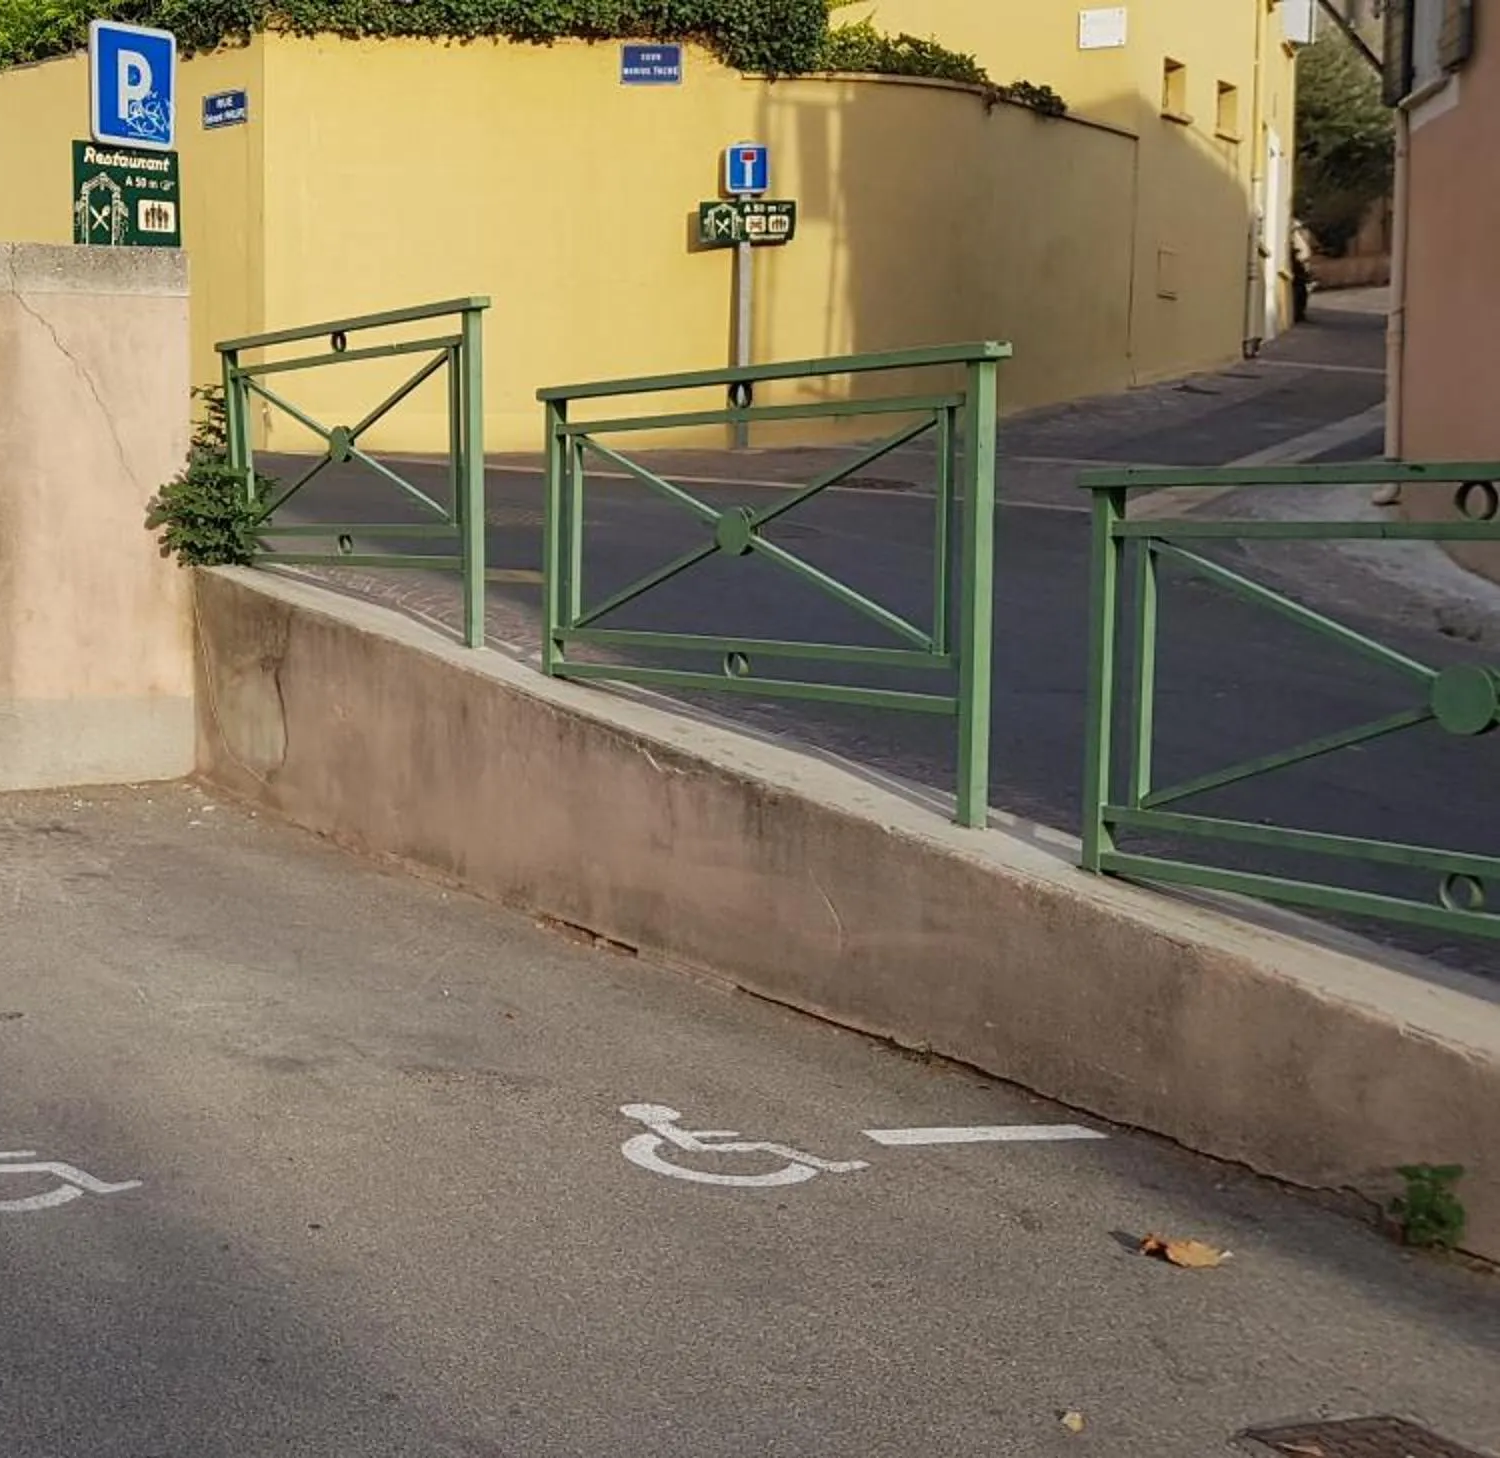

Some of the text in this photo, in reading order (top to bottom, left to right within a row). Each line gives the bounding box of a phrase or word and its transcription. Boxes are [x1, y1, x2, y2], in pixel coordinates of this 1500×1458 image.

[118, 48, 152, 119] P
[215, 96, 233, 109] RUE
[84, 146, 169, 171] Restaurant
[125, 175, 133, 187] A
[135, 176, 147, 189] 50
